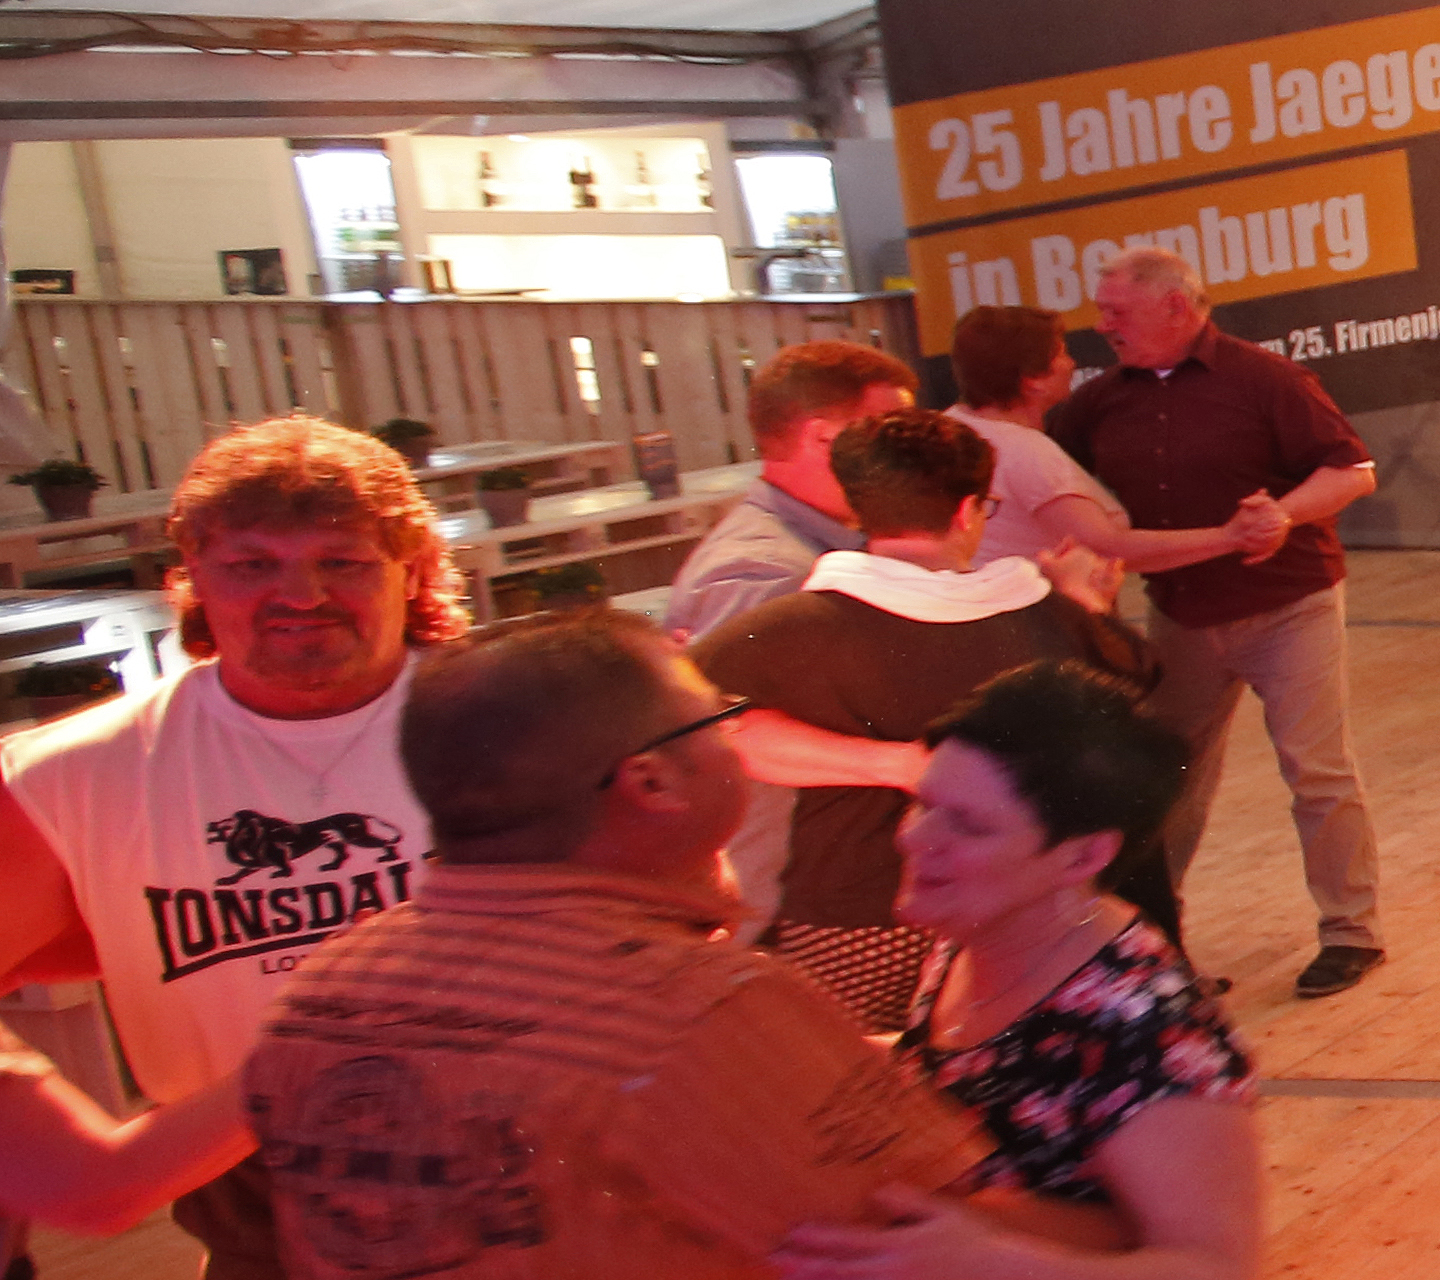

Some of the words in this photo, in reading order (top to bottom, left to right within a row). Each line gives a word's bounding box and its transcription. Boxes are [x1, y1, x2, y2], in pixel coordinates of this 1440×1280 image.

[929, 109, 1023, 200] 25
[1039, 85, 1233, 183] Jahre
[947, 251, 1021, 318] in
[1289, 325, 1333, 362] 25.
[144, 858, 415, 983] LONSDAL
